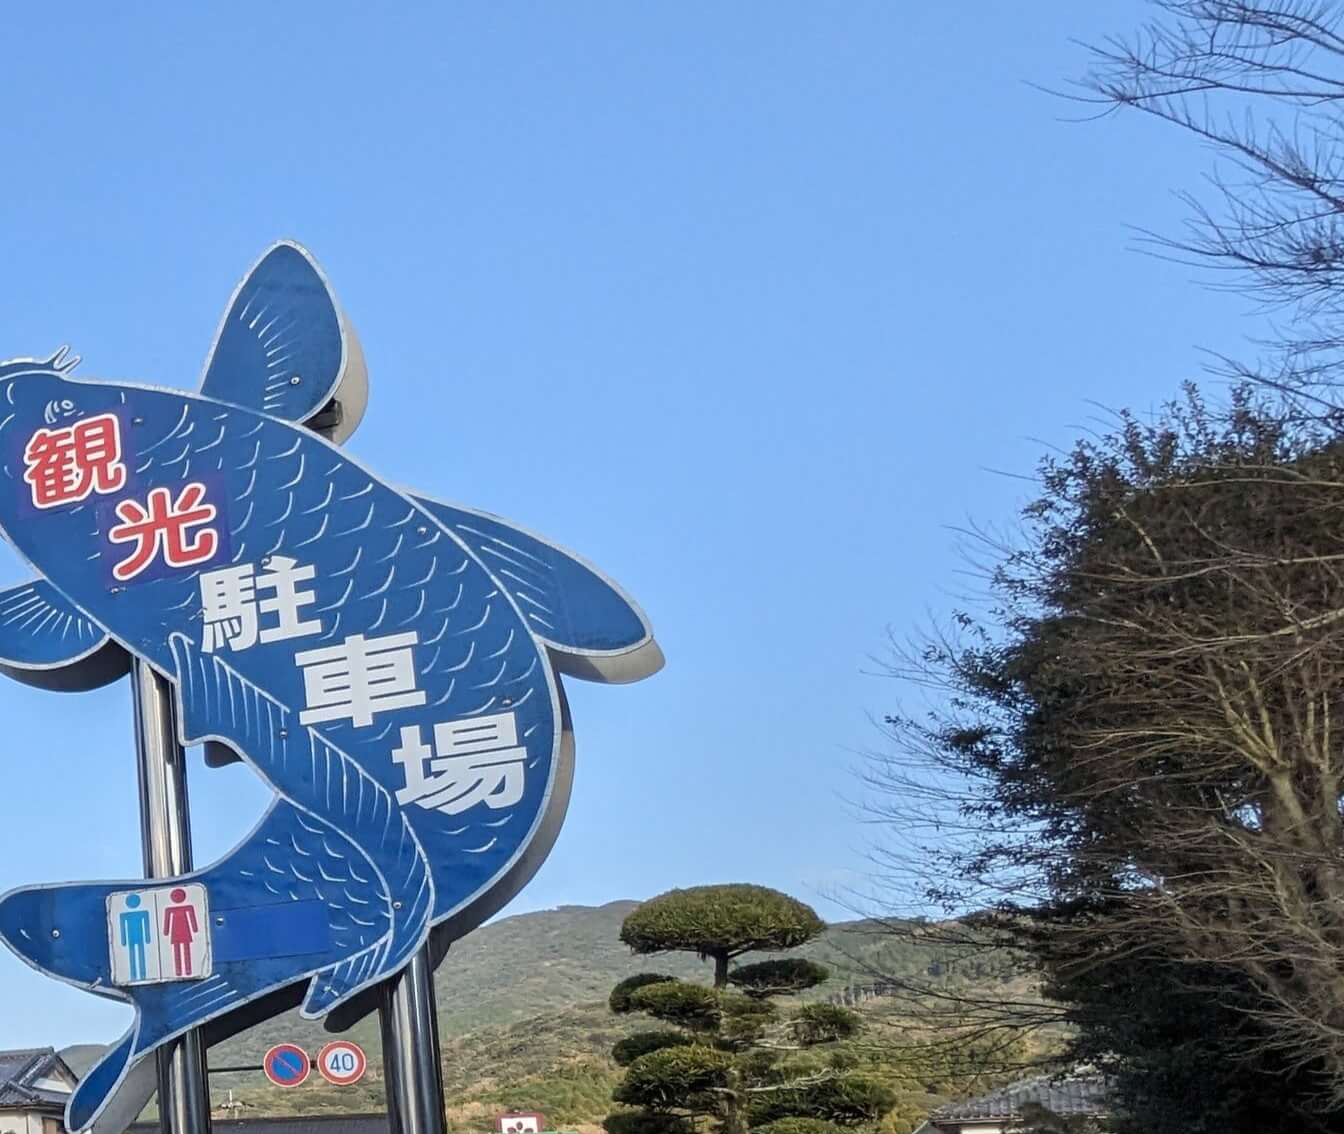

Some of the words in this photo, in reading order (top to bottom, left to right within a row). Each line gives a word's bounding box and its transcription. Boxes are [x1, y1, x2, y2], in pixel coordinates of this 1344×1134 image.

[24, 414, 528, 816] 観光駐車場
[330, 1053, 354, 1073] 40
